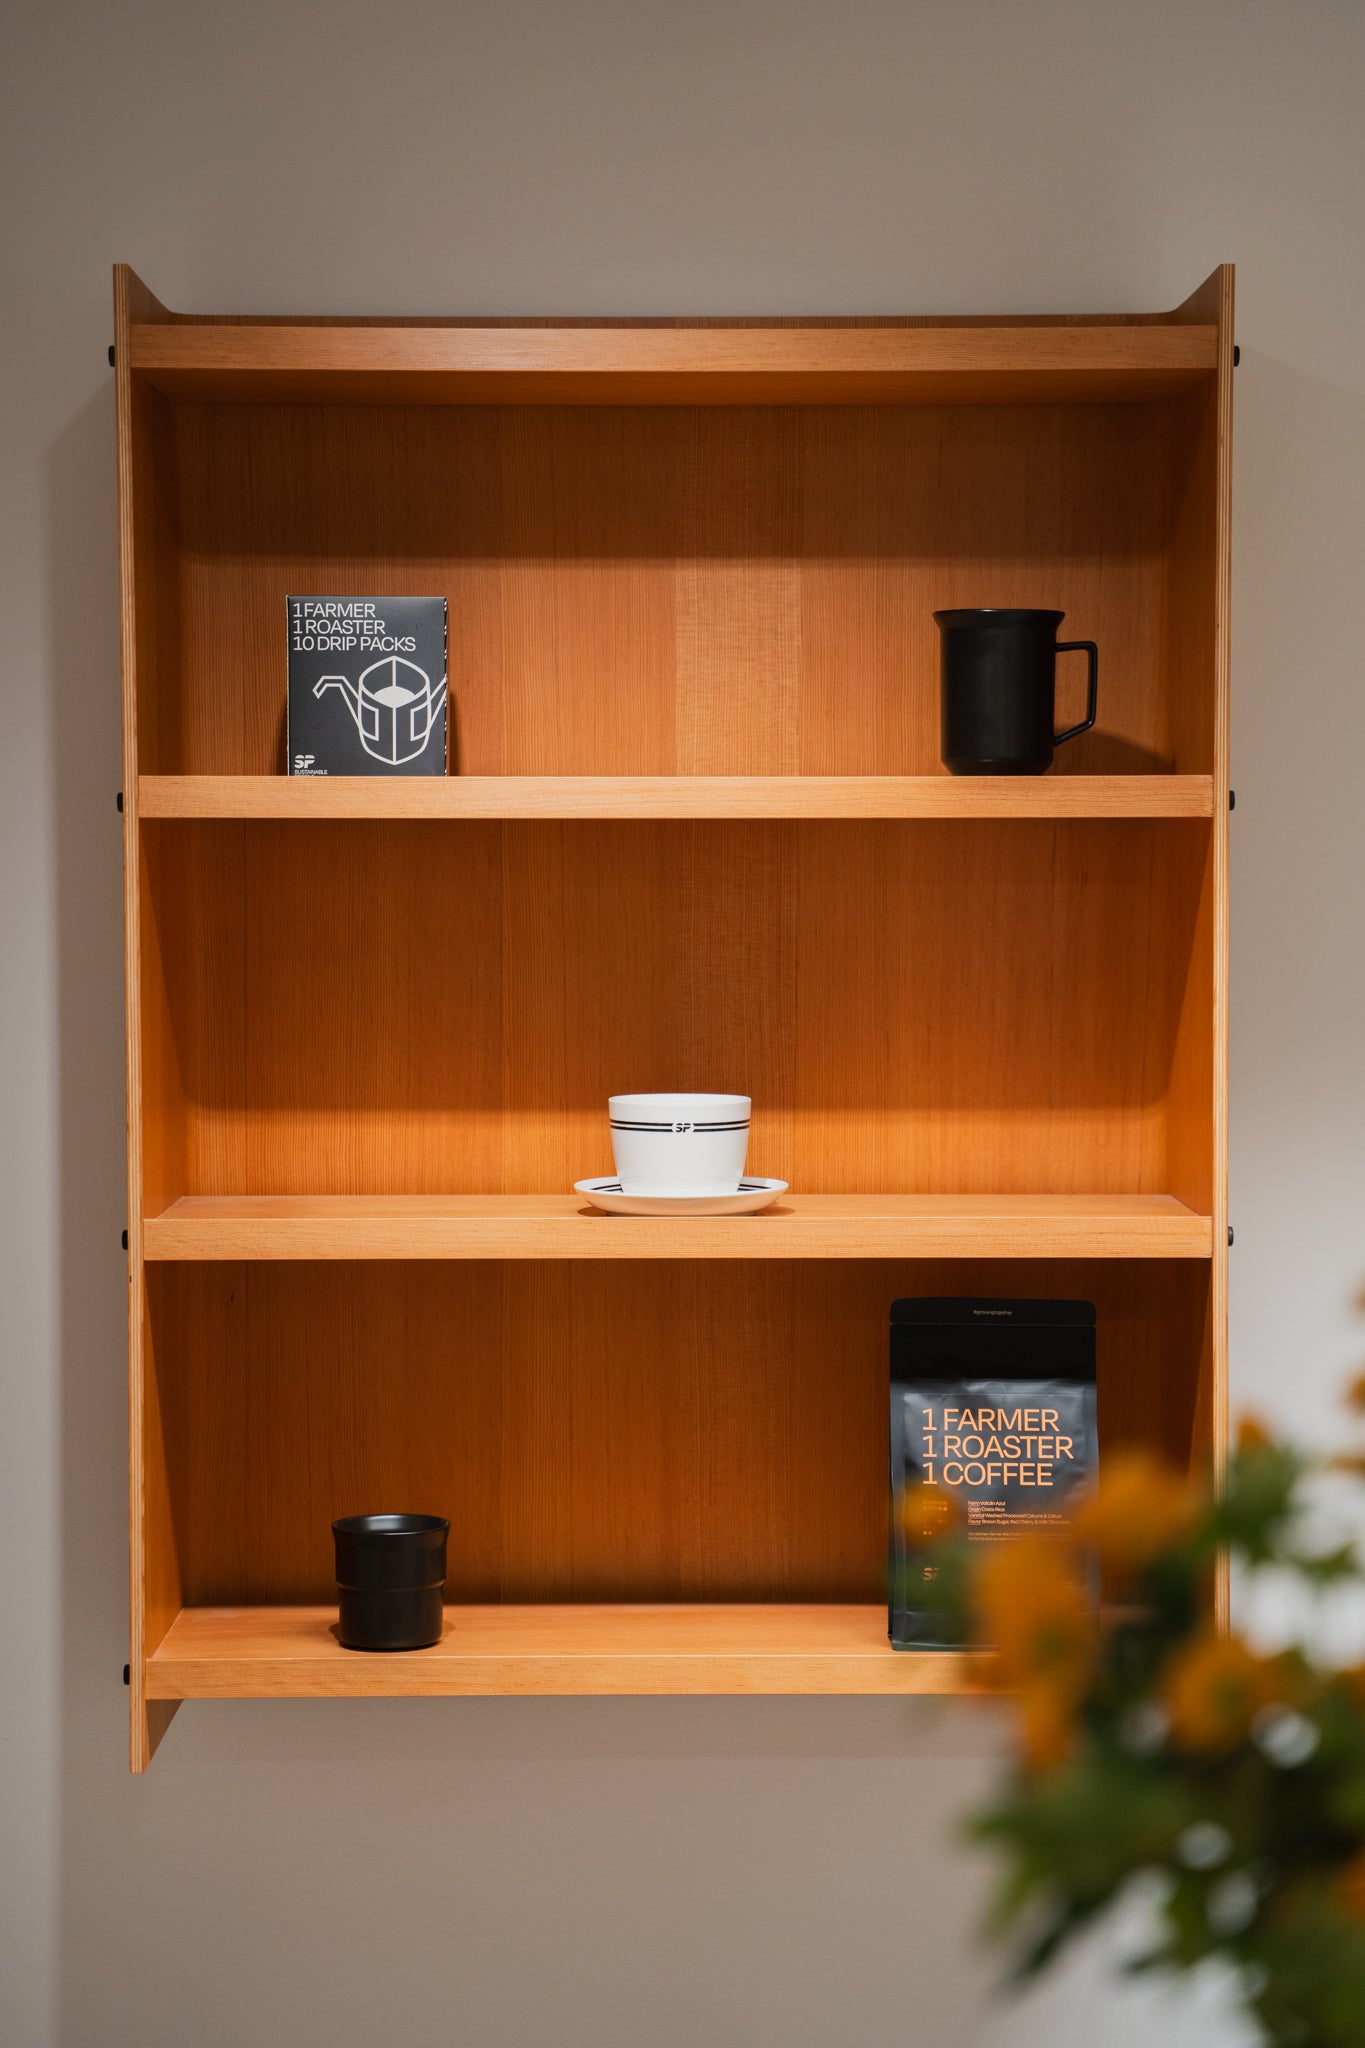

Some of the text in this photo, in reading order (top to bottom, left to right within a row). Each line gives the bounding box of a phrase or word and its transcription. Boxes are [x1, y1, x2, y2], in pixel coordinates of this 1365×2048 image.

[293, 603, 376, 618] 1 FARMER
[293, 620, 386, 635] 1 ROASTER
[293, 636, 416, 652] 10 DRIP PACKS
[294, 754, 315, 769] SP
[676, 1123, 691, 1133] SP
[922, 1408, 1060, 1432] 1 FARMER
[922, 1434, 1075, 1459] 1 ROASTER
[922, 1461, 1054, 1486] 1 COFFEE
